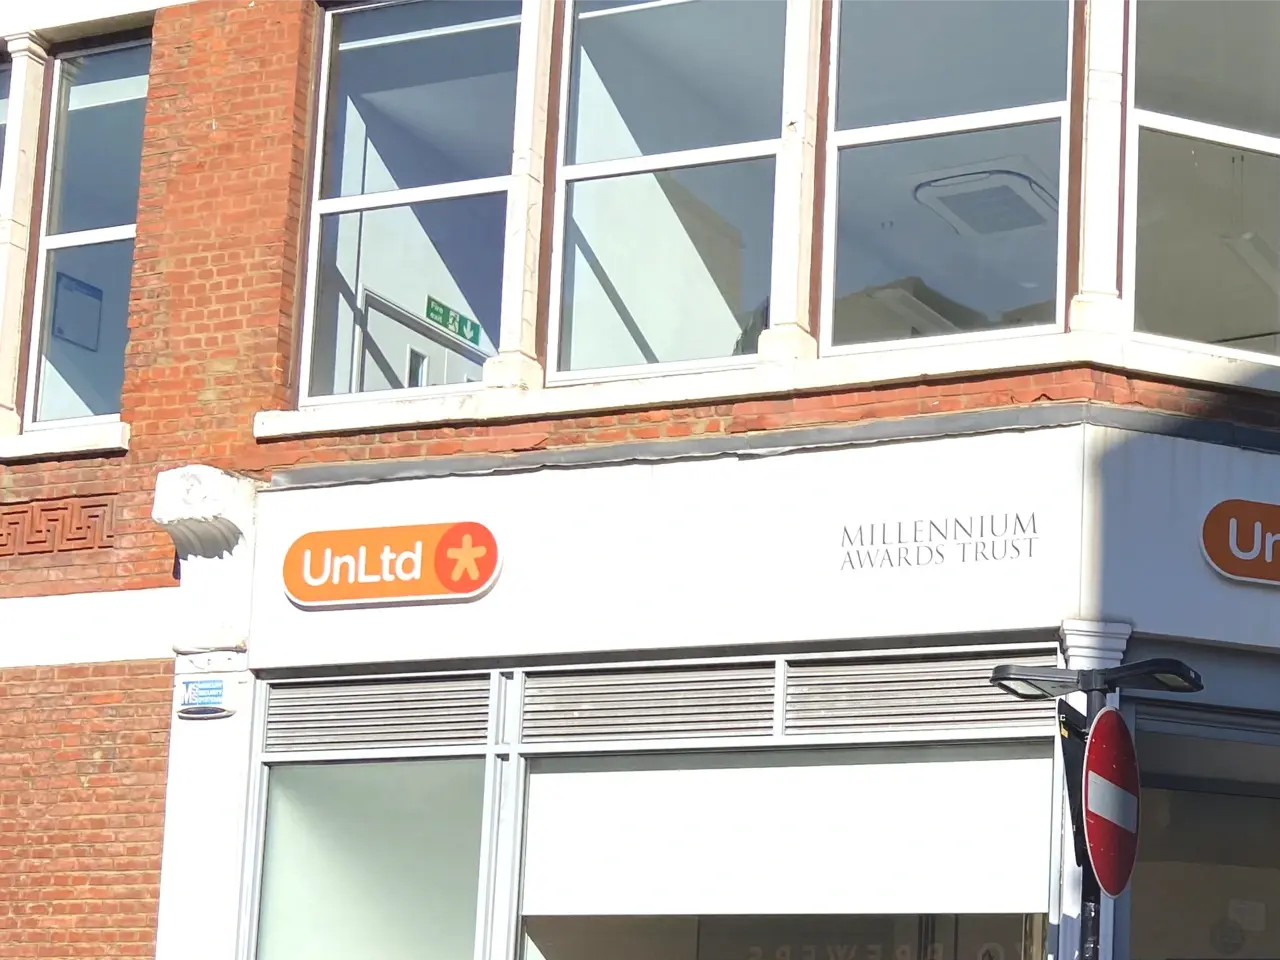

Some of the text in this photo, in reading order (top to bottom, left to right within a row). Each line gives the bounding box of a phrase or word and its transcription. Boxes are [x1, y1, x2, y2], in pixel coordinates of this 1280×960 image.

[429, 312, 443, 324] exit
[430, 301, 444, 314] Fire
[840, 512, 1039, 548] MILLENNIUM
[302, 540, 424, 588] UnLtd
[840, 537, 1039, 571] AWARDS TRUST
